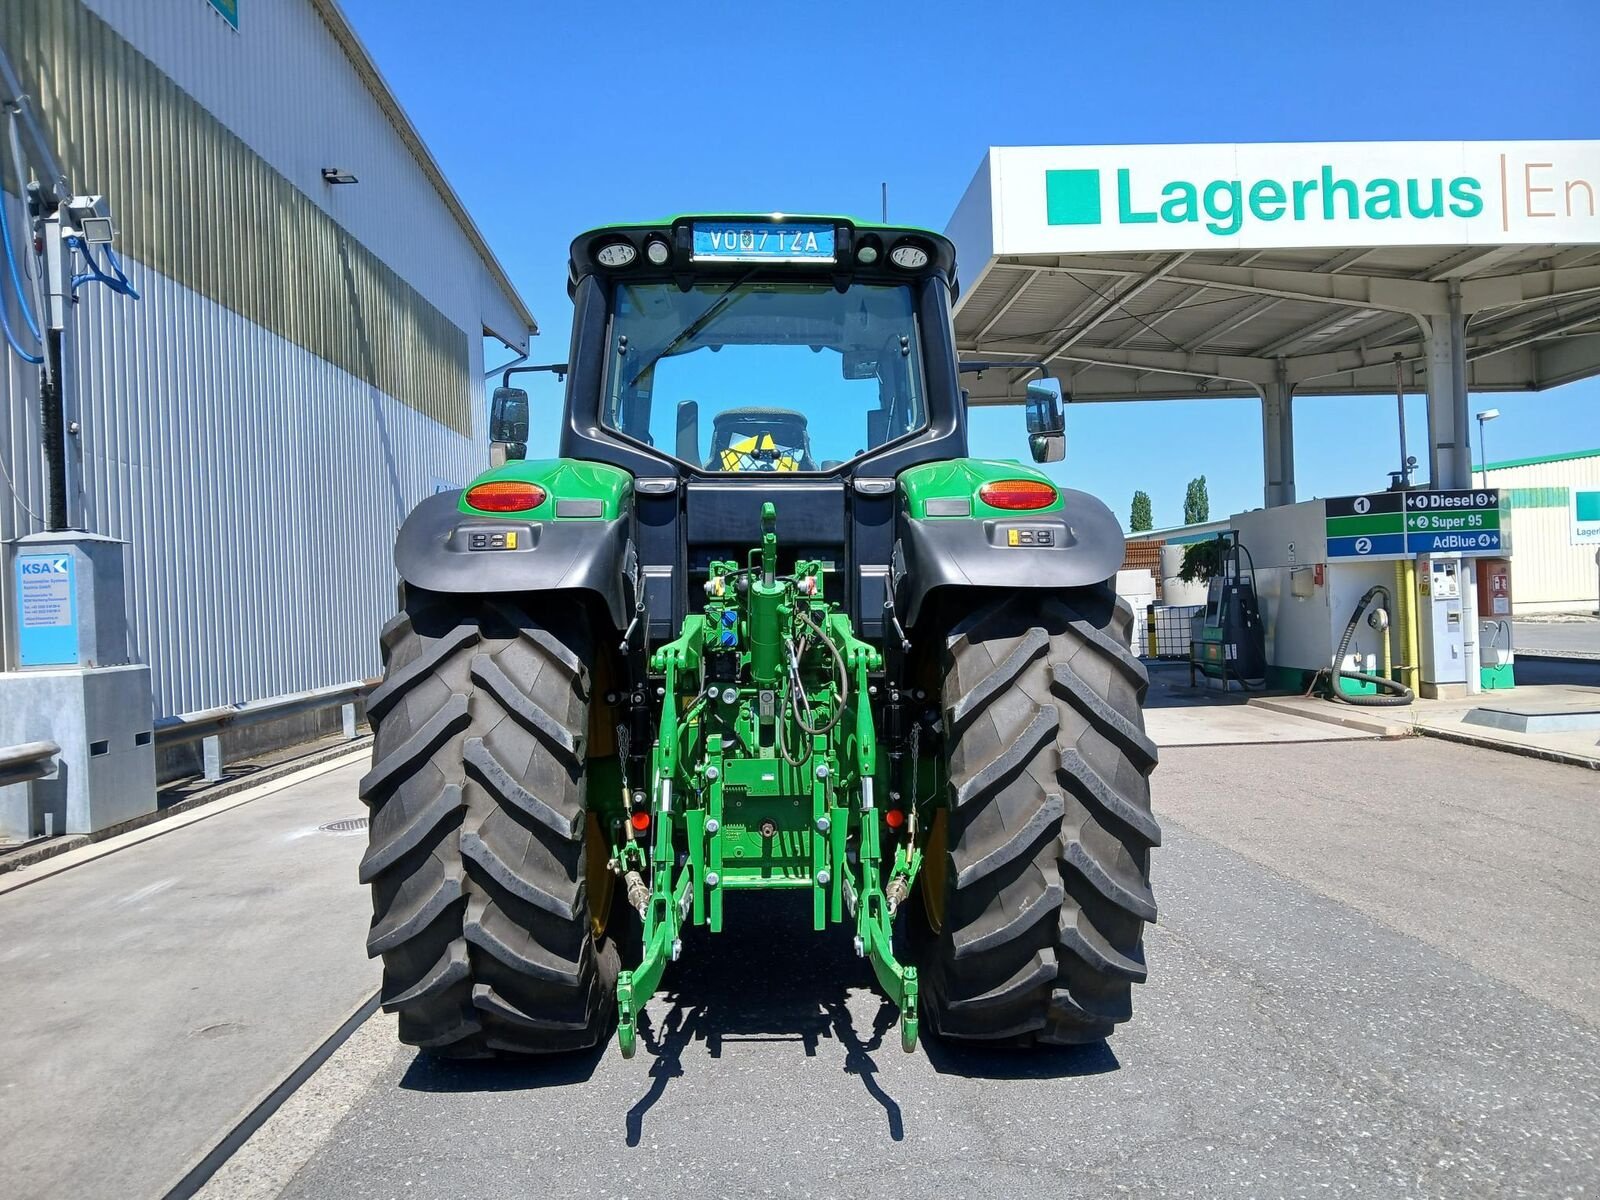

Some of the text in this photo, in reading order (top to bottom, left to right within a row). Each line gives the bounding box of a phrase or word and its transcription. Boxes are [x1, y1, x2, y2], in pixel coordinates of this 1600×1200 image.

[1117, 165, 1484, 235] Lagerhaus
[710, 229, 738, 250] VO
[1430, 494, 1474, 508] Diesel
[1431, 516, 1465, 529] Super
[1468, 515, 1482, 527] 95
[1433, 535, 1476, 548] AdBlue
[22, 562, 51, 575] KSA
